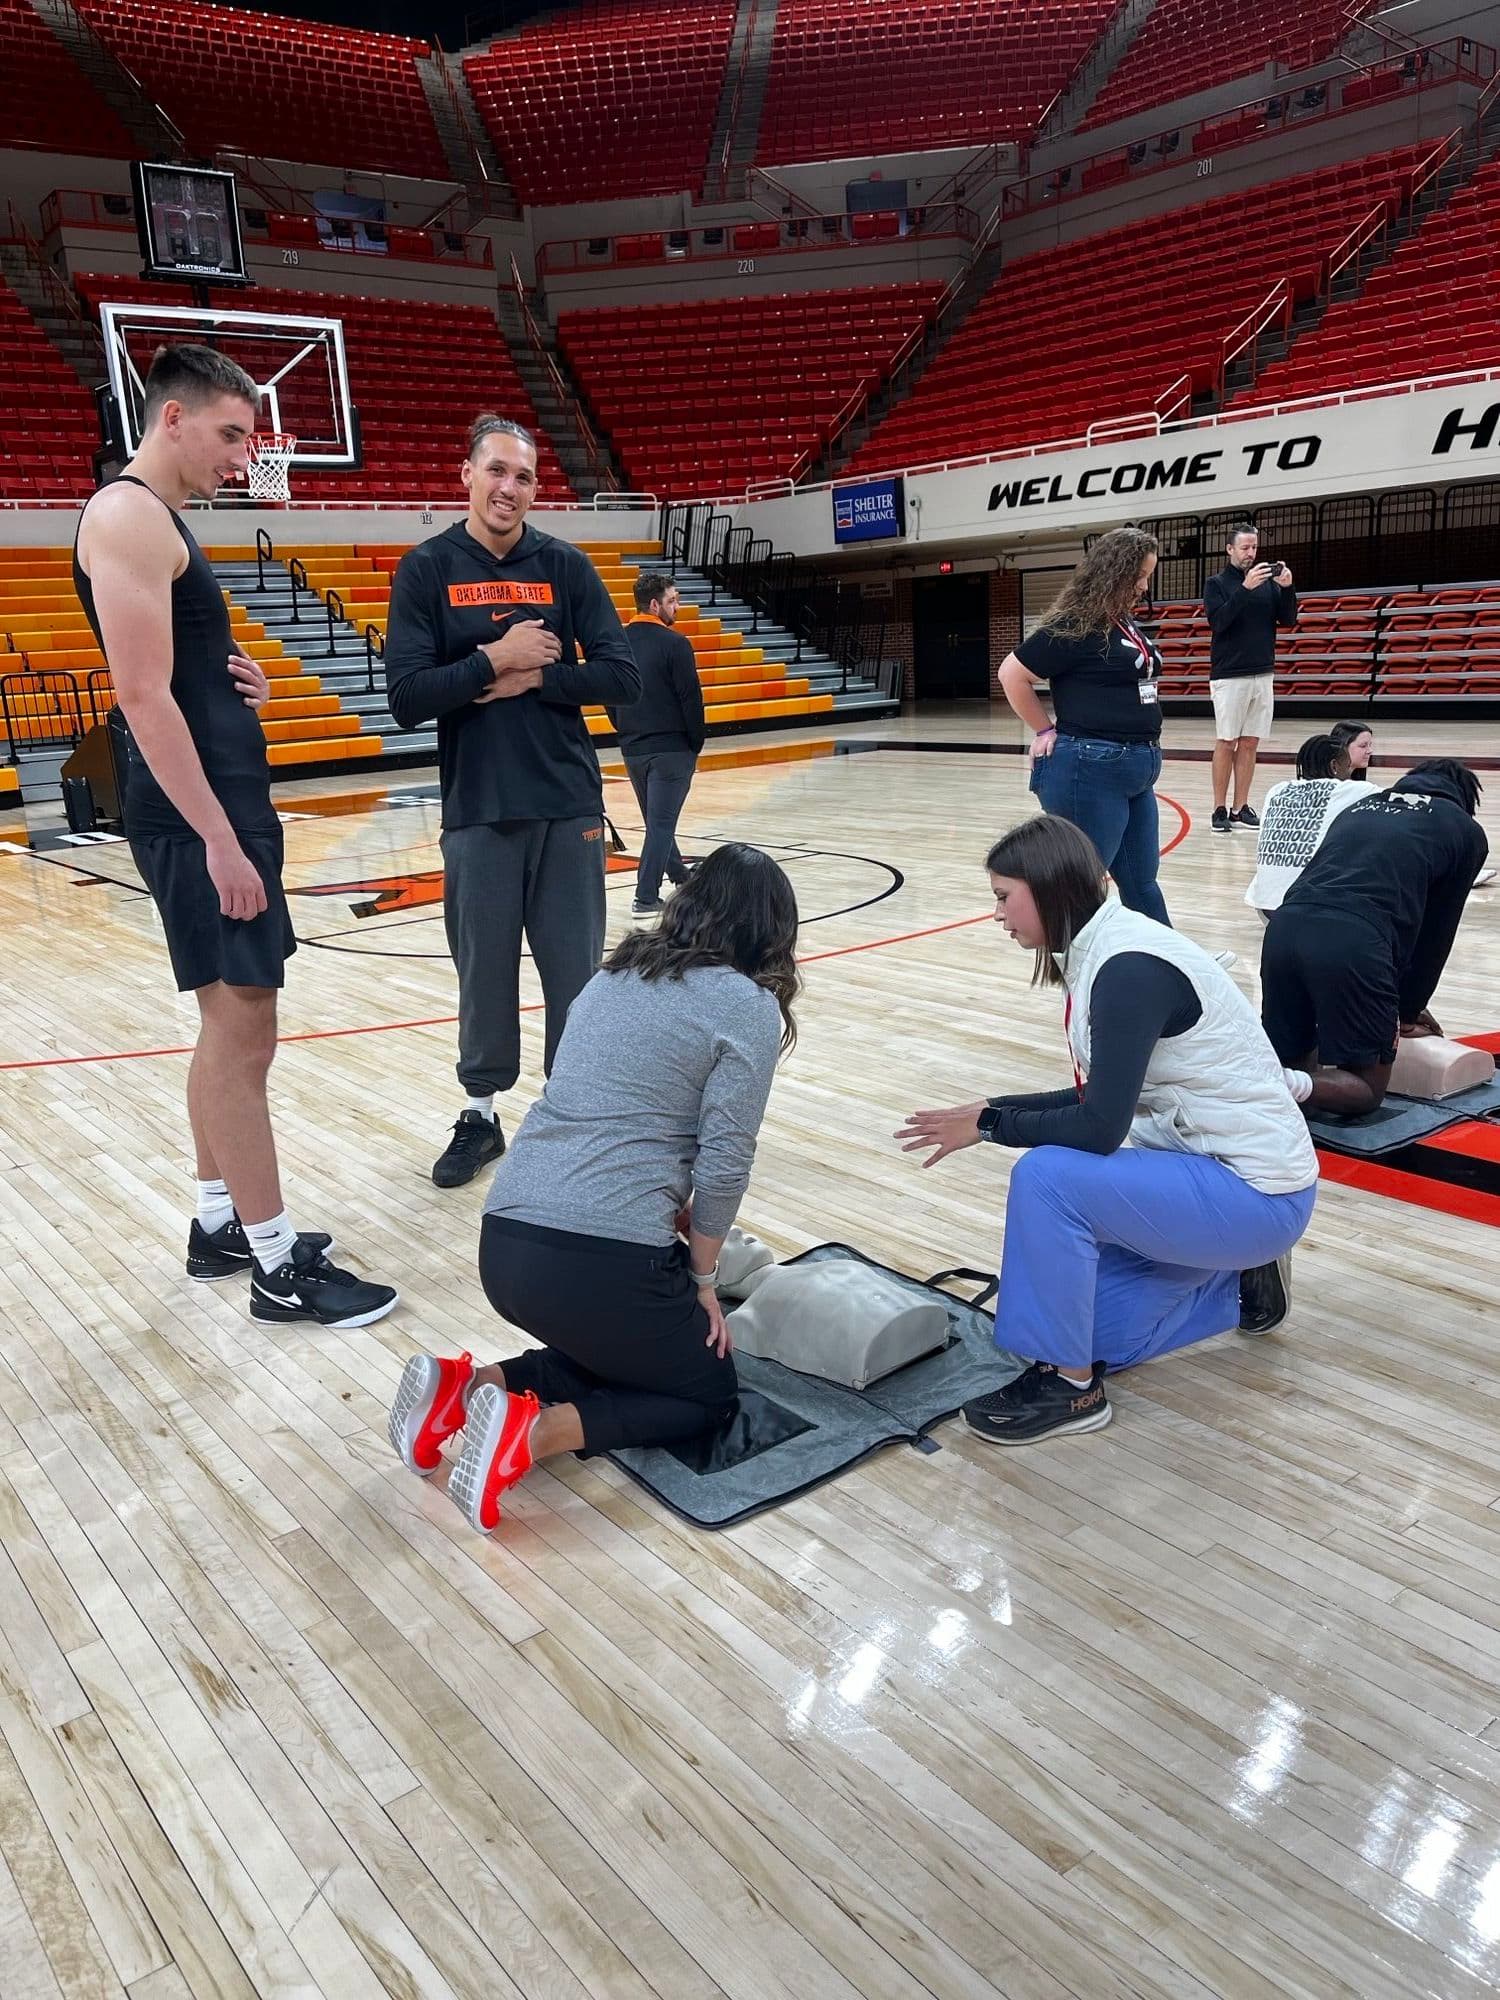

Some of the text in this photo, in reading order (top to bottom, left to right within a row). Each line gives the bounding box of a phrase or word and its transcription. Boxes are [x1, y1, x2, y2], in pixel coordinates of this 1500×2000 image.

[1197, 158, 1212, 177] 201
[282, 249, 299, 265] 219
[737, 259, 755, 273] 220
[987, 402, 1500, 511] WELCOME TO H
[854, 493, 893, 513] SHELTER
[855, 509, 895, 524] INSURANCE
[456, 585, 545, 602] OKLAHOMA STATE
[1257, 840, 1316, 855] OTORIOUS
[1070, 1387, 1104, 1413] HOKA
